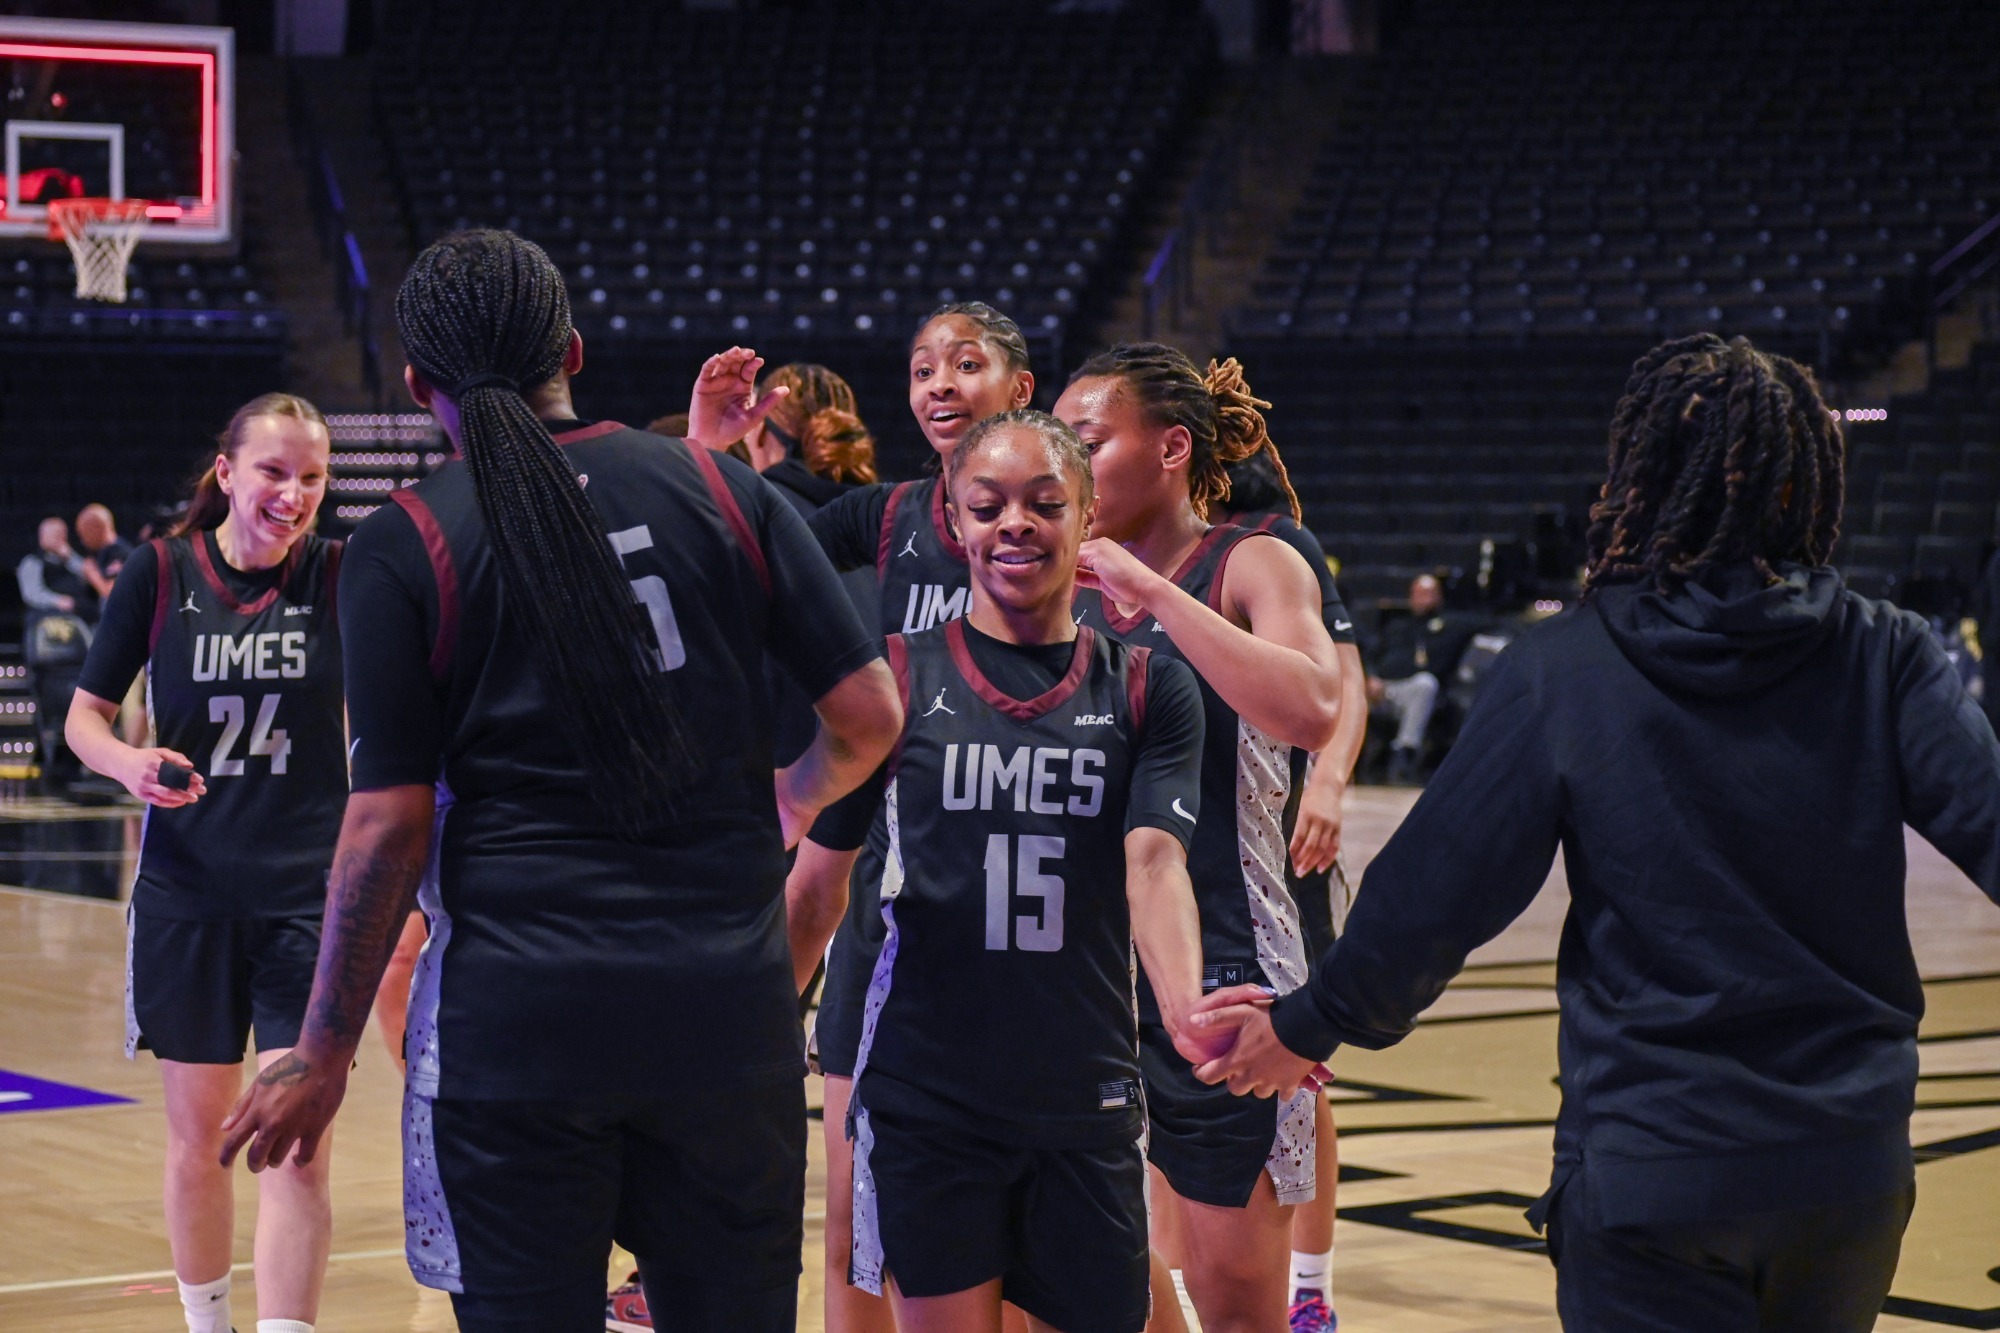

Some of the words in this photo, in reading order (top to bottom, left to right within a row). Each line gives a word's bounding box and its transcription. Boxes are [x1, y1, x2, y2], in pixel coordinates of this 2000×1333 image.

[902, 584, 973, 633] UM
[193, 631, 306, 682] UMES
[209, 694, 292, 776] 24
[1074, 714, 1114, 726] MEAC
[943, 744, 1106, 817] UMES
[984, 834, 1066, 952] 15
[1226, 970, 1237, 981] M
[1129, 1087, 1135, 1099] S
